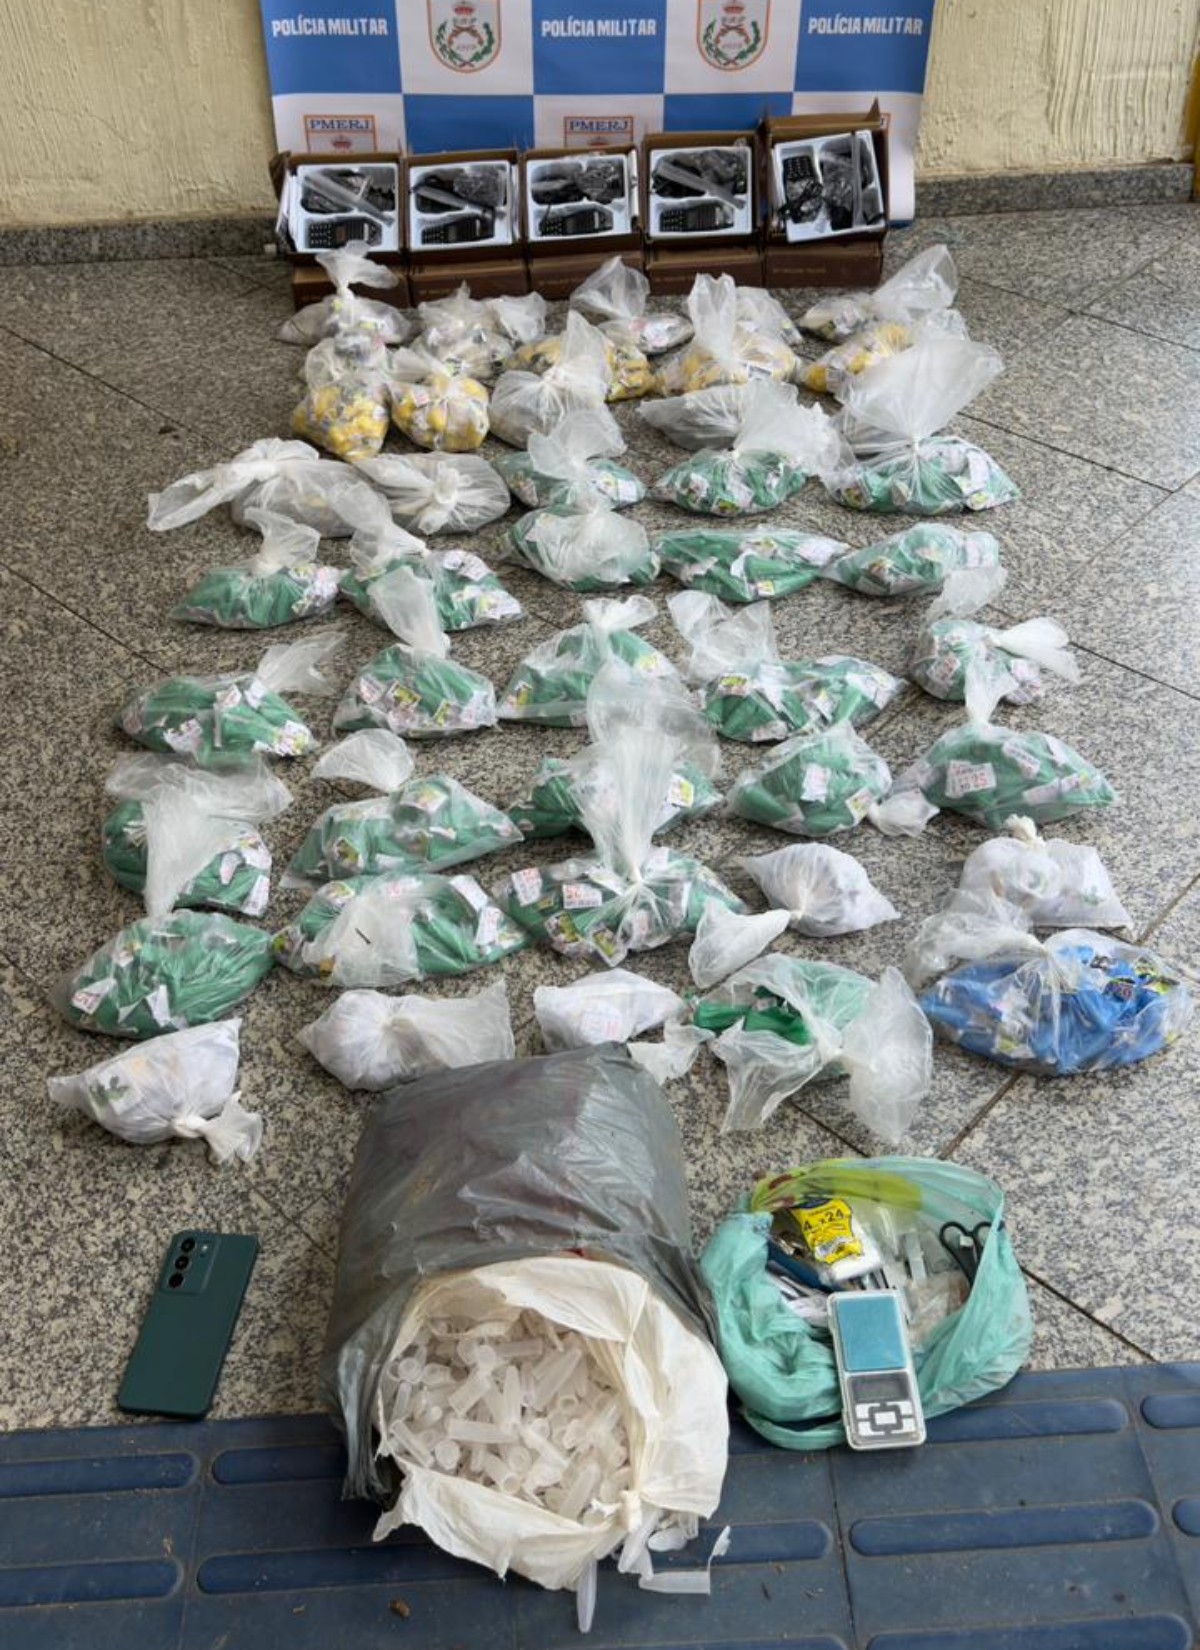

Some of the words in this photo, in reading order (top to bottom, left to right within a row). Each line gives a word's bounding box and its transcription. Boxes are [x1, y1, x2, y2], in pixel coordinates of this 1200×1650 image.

[271, 14, 326, 37] POLÍCIA
[327, 18, 389, 36] MILITAR
[541, 15, 595, 37] POLÍCIA
[596, 18, 657, 36] MILITAR
[807, 12, 861, 35] POLÍCIA
[862, 16, 923, 36] MILITAR
[310, 118, 370, 130] PMERJ
[569, 120, 629, 132] PMERJ
